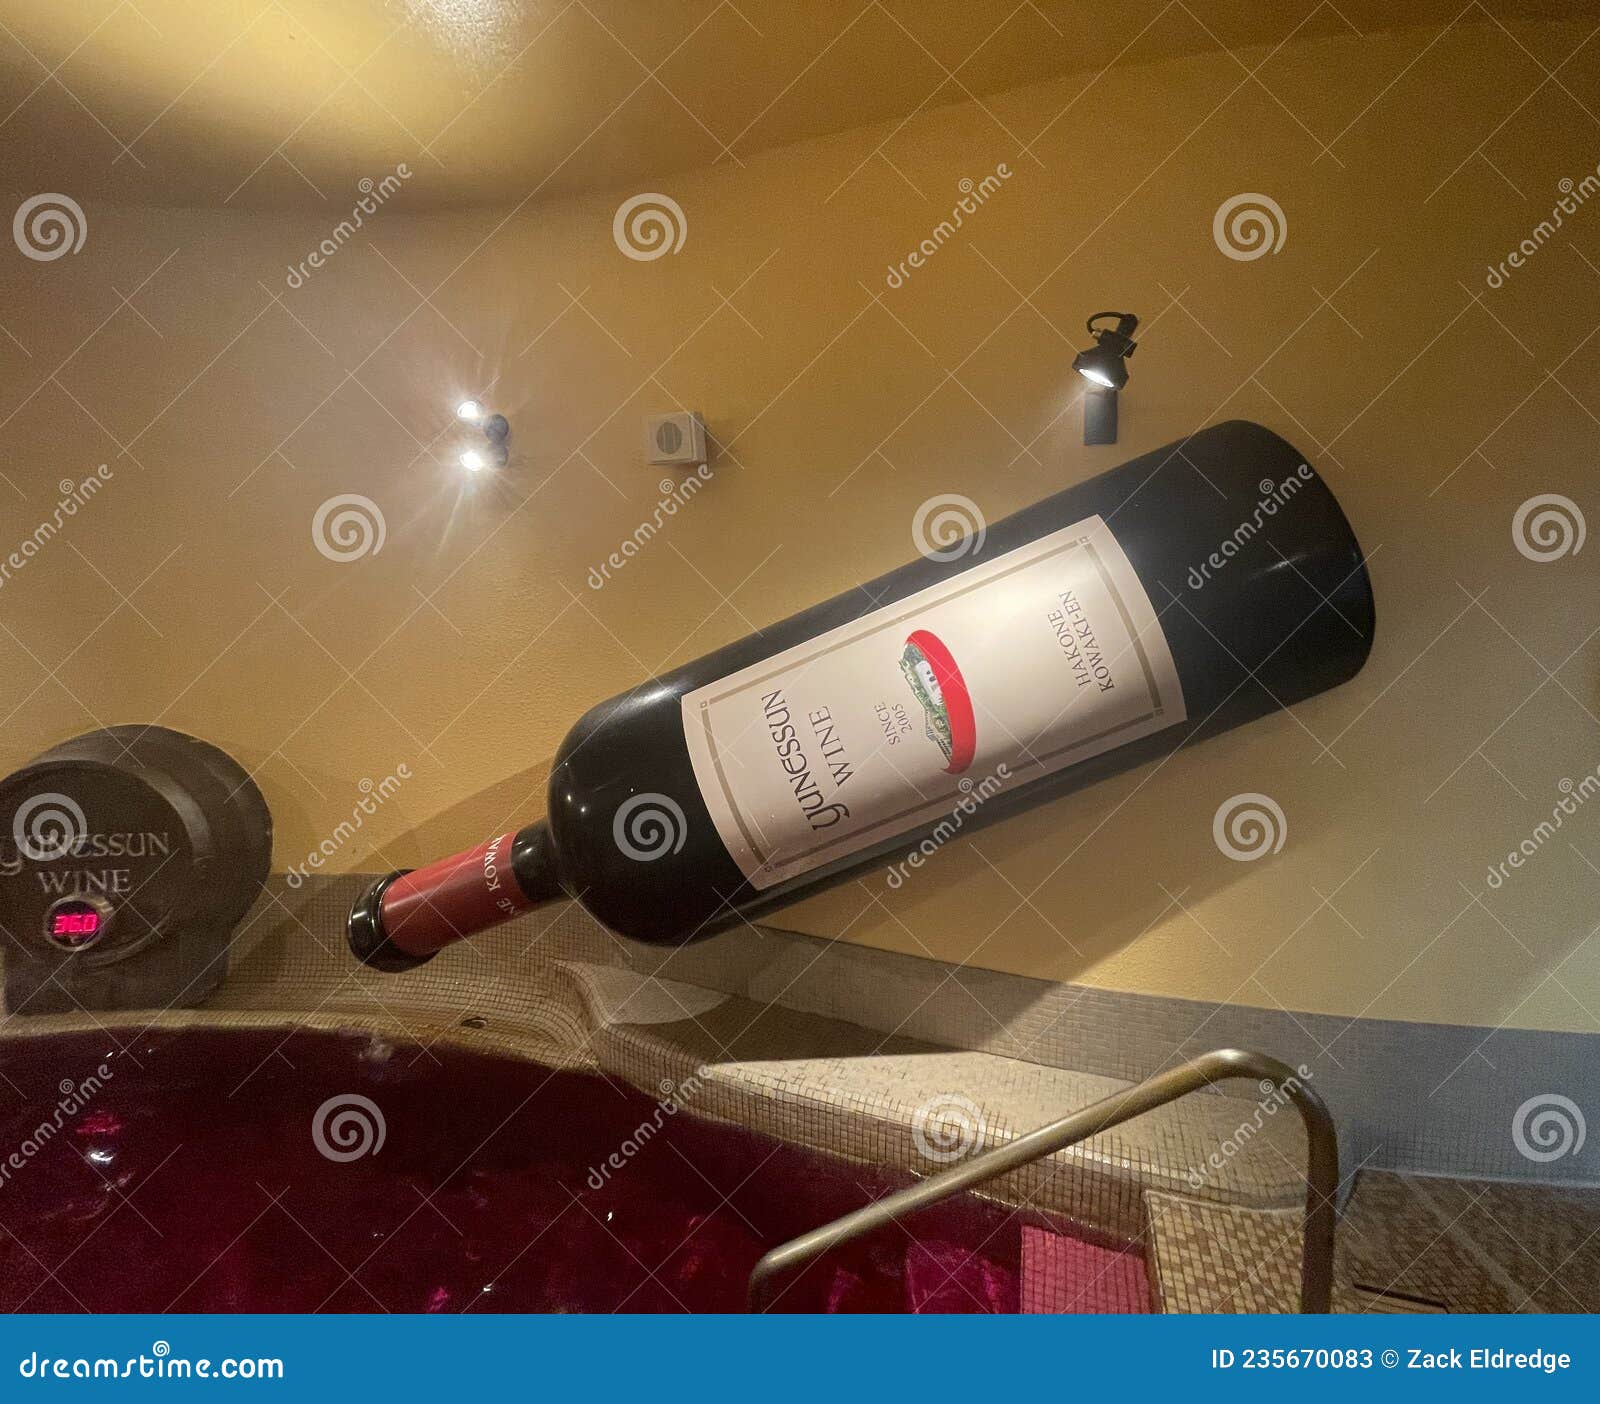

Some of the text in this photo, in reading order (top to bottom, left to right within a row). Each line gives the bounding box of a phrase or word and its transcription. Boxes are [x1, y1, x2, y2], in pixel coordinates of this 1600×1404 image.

[1047, 610, 1091, 687] HAKONE
[1059, 590, 1115, 693] KOWAKI-EN
[808, 705, 854, 787] WINE
[874, 701, 900, 745] SINCE
[891, 703, 912, 734] 2005
[37, 869, 132, 894] WINE
